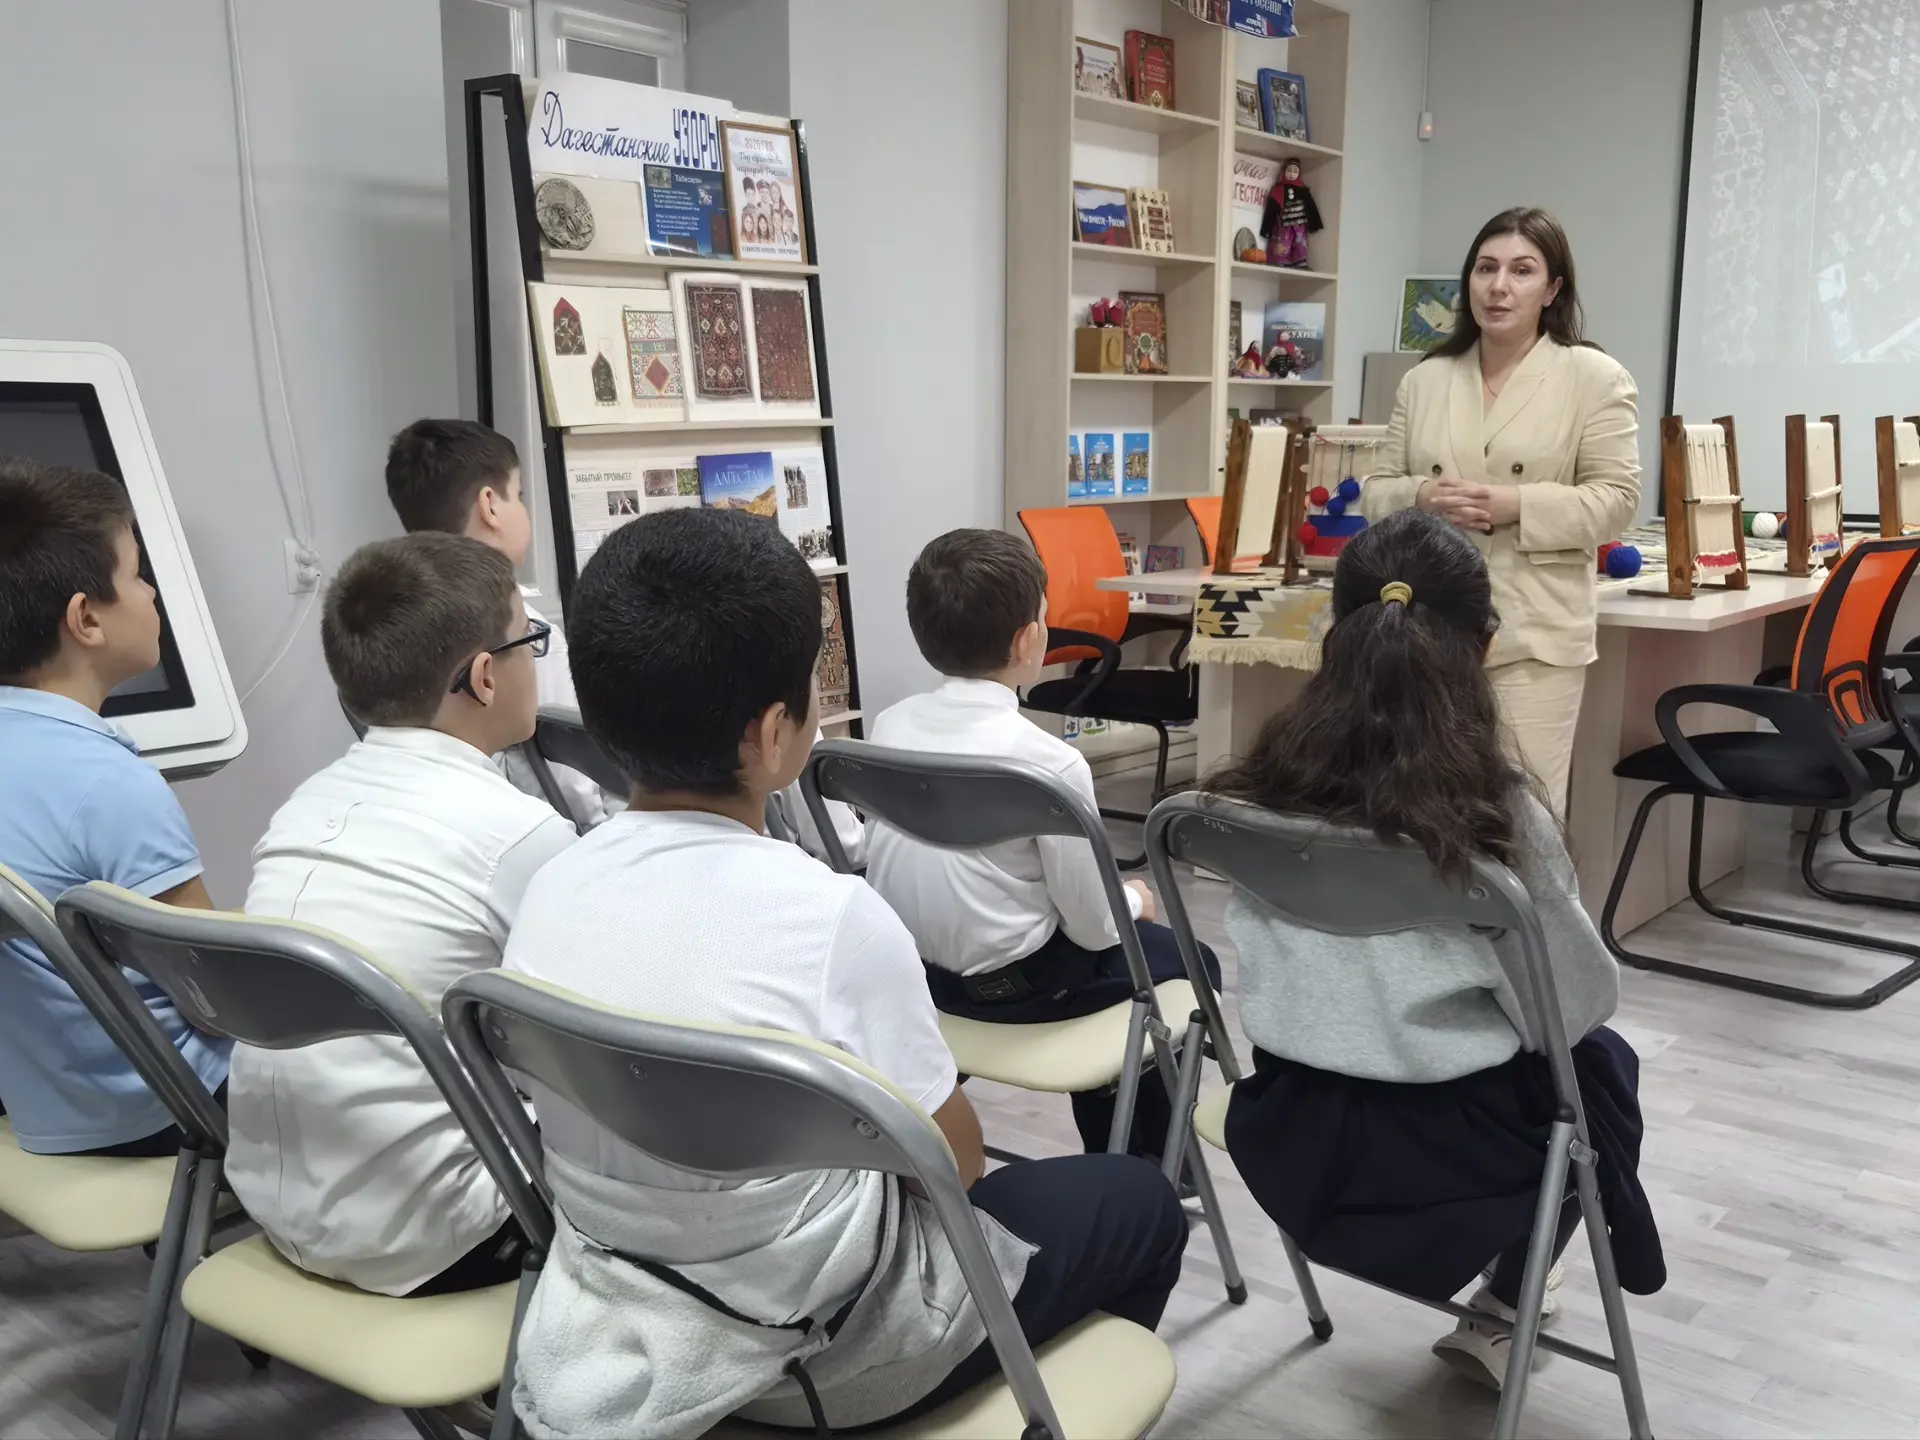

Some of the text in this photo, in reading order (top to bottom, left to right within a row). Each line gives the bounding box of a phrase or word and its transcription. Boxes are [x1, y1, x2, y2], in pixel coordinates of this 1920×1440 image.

[541, 91, 724, 171] Дагестанские УЗОРЫ
[1233, 182, 1268, 206] ГЕСТАН
